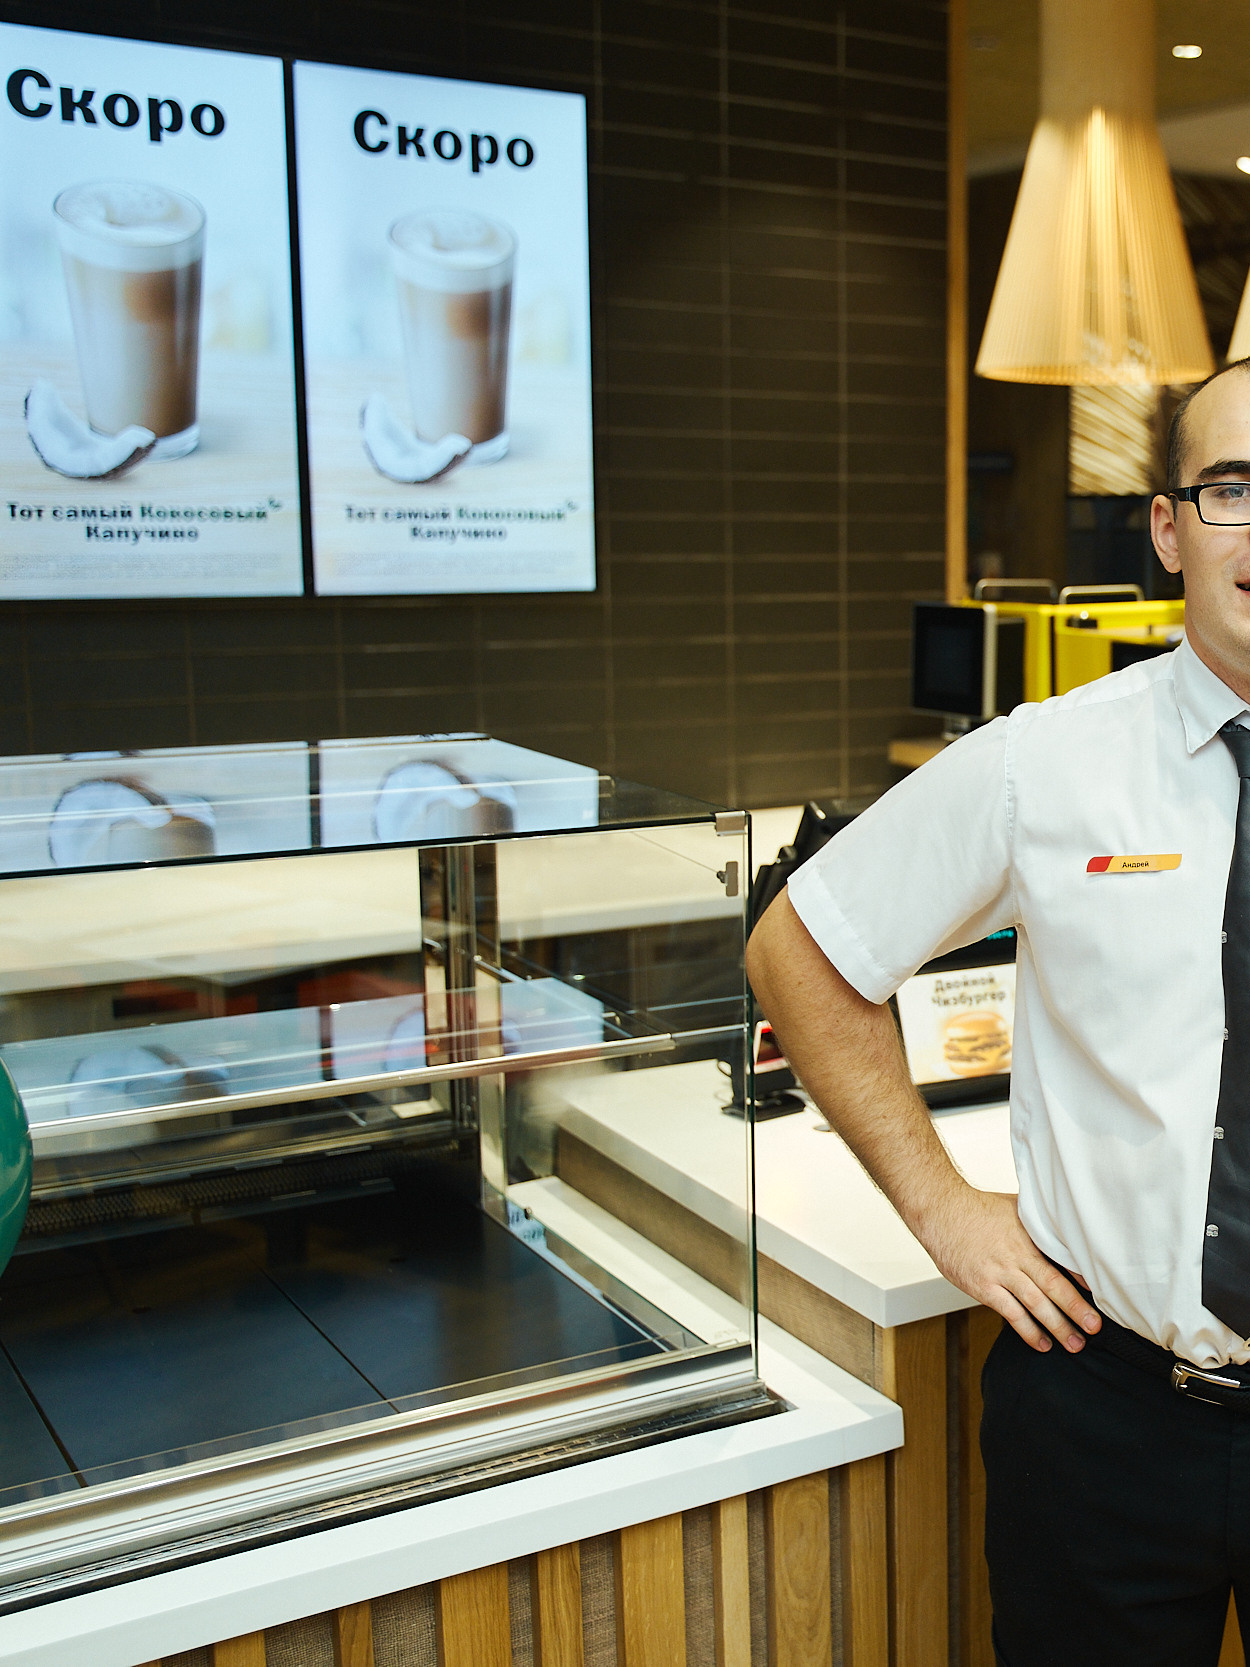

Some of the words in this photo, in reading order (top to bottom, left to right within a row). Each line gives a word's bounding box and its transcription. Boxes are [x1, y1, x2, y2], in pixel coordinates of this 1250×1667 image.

[6, 68, 226, 142] Скоро
[353, 110, 534, 173] Скоро
[8, 504, 44, 520] Тот
[52, 504, 133, 520] самый
